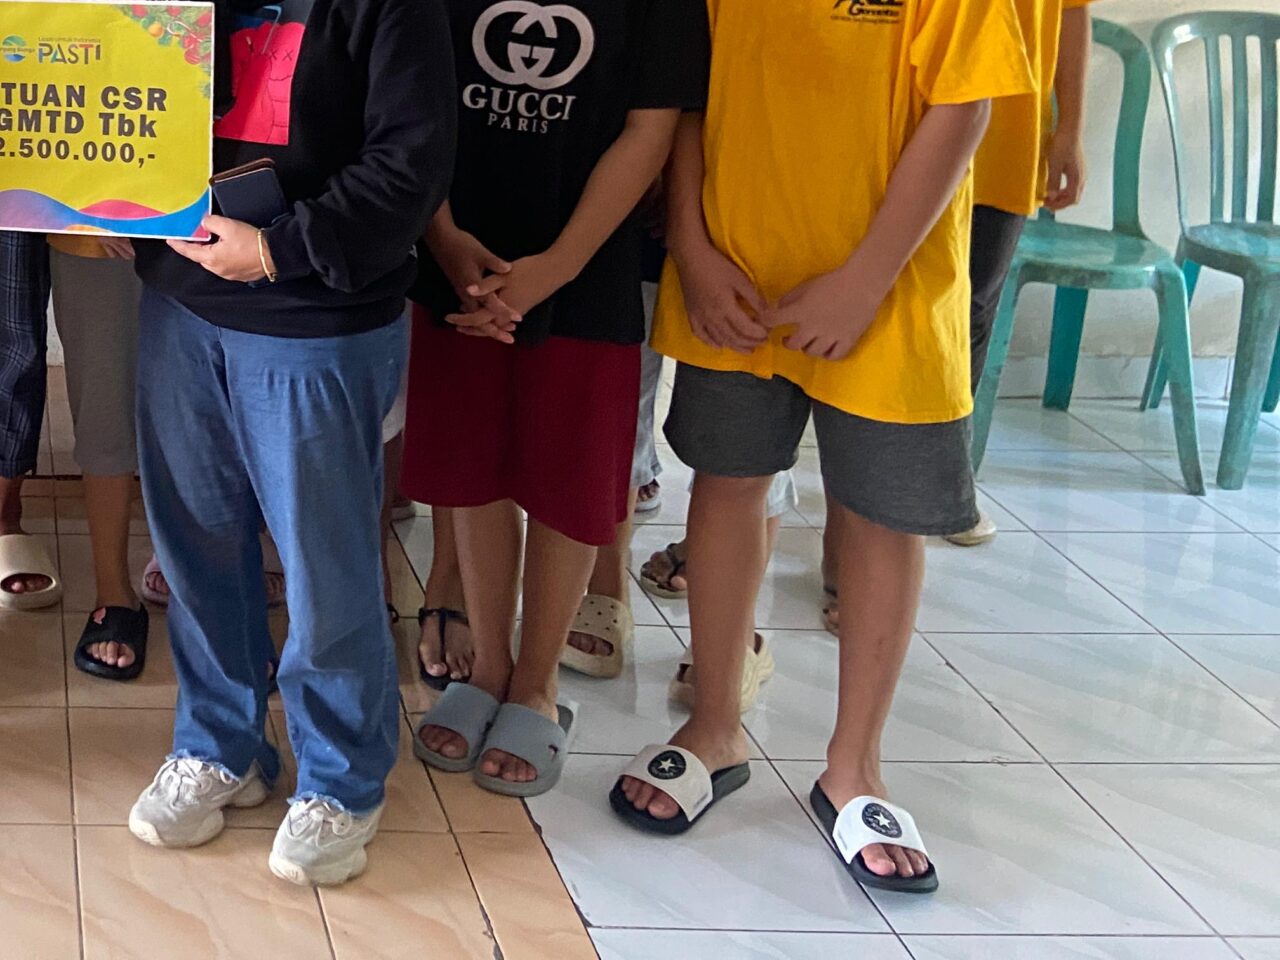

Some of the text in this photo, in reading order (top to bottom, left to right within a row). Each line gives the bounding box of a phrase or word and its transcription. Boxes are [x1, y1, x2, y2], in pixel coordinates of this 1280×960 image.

[101, 86, 167, 112] CSR
[462, 84, 576, 120] GUCCI
[99, 112, 157, 138] Tbk
[487, 113, 549, 134] PARIS
